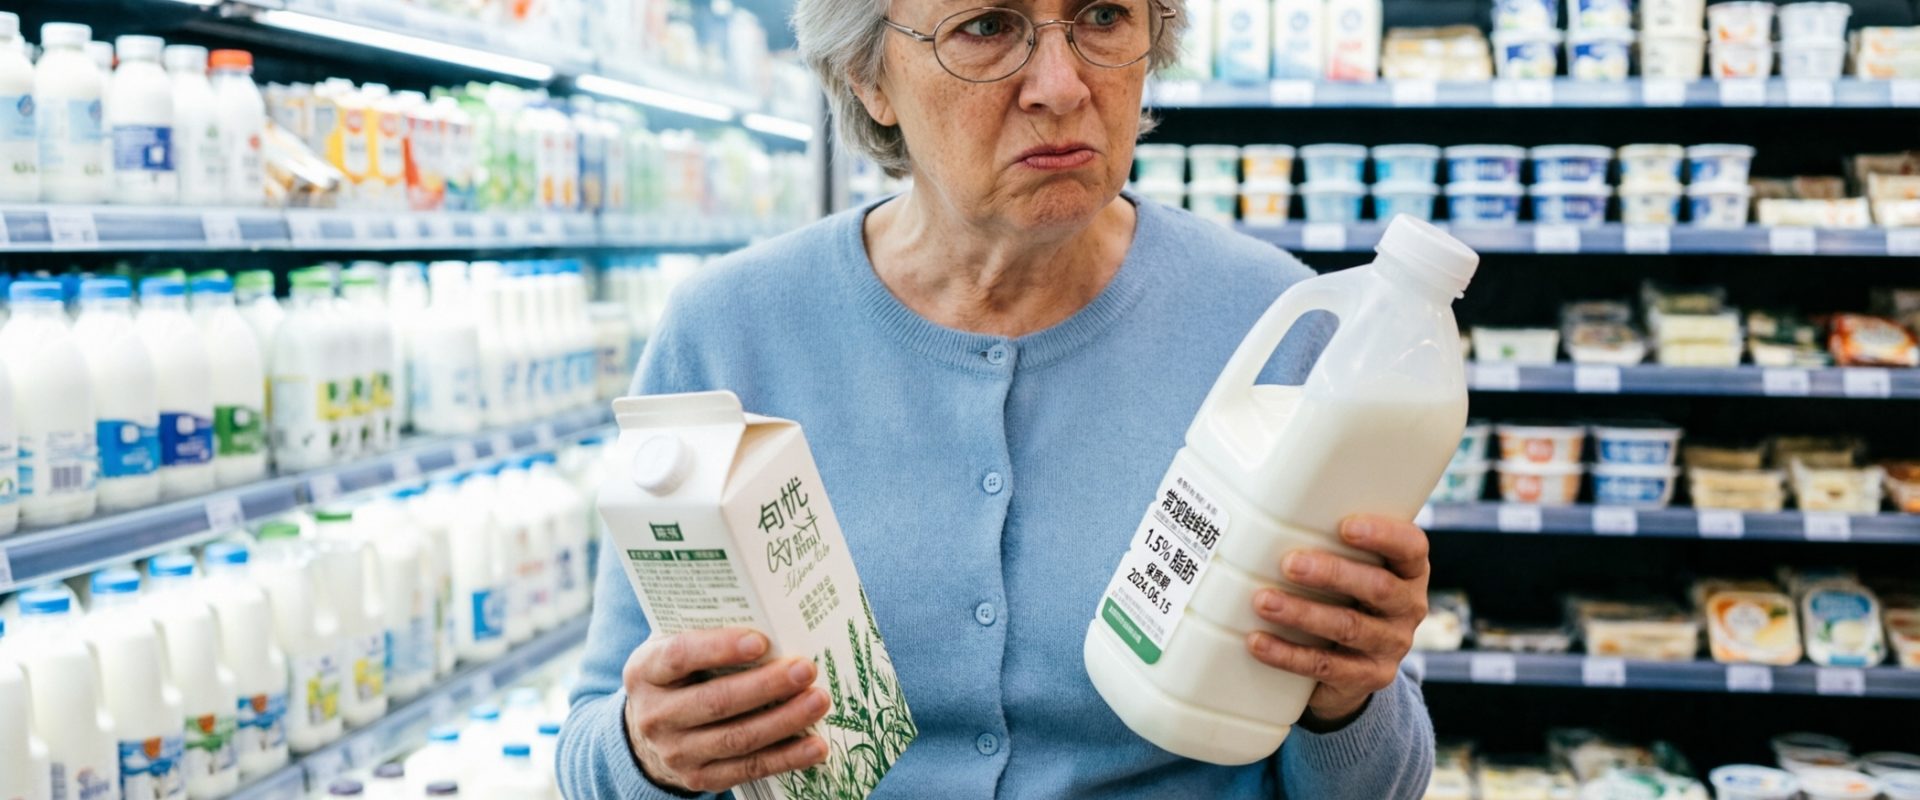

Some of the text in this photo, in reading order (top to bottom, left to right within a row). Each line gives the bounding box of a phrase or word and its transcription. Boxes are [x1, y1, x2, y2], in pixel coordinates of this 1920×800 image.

[1145, 528, 1173, 561] 1.5%
[1169, 548, 1199, 585] 脂肪
[1127, 567, 1172, 614] 2024.06.15
